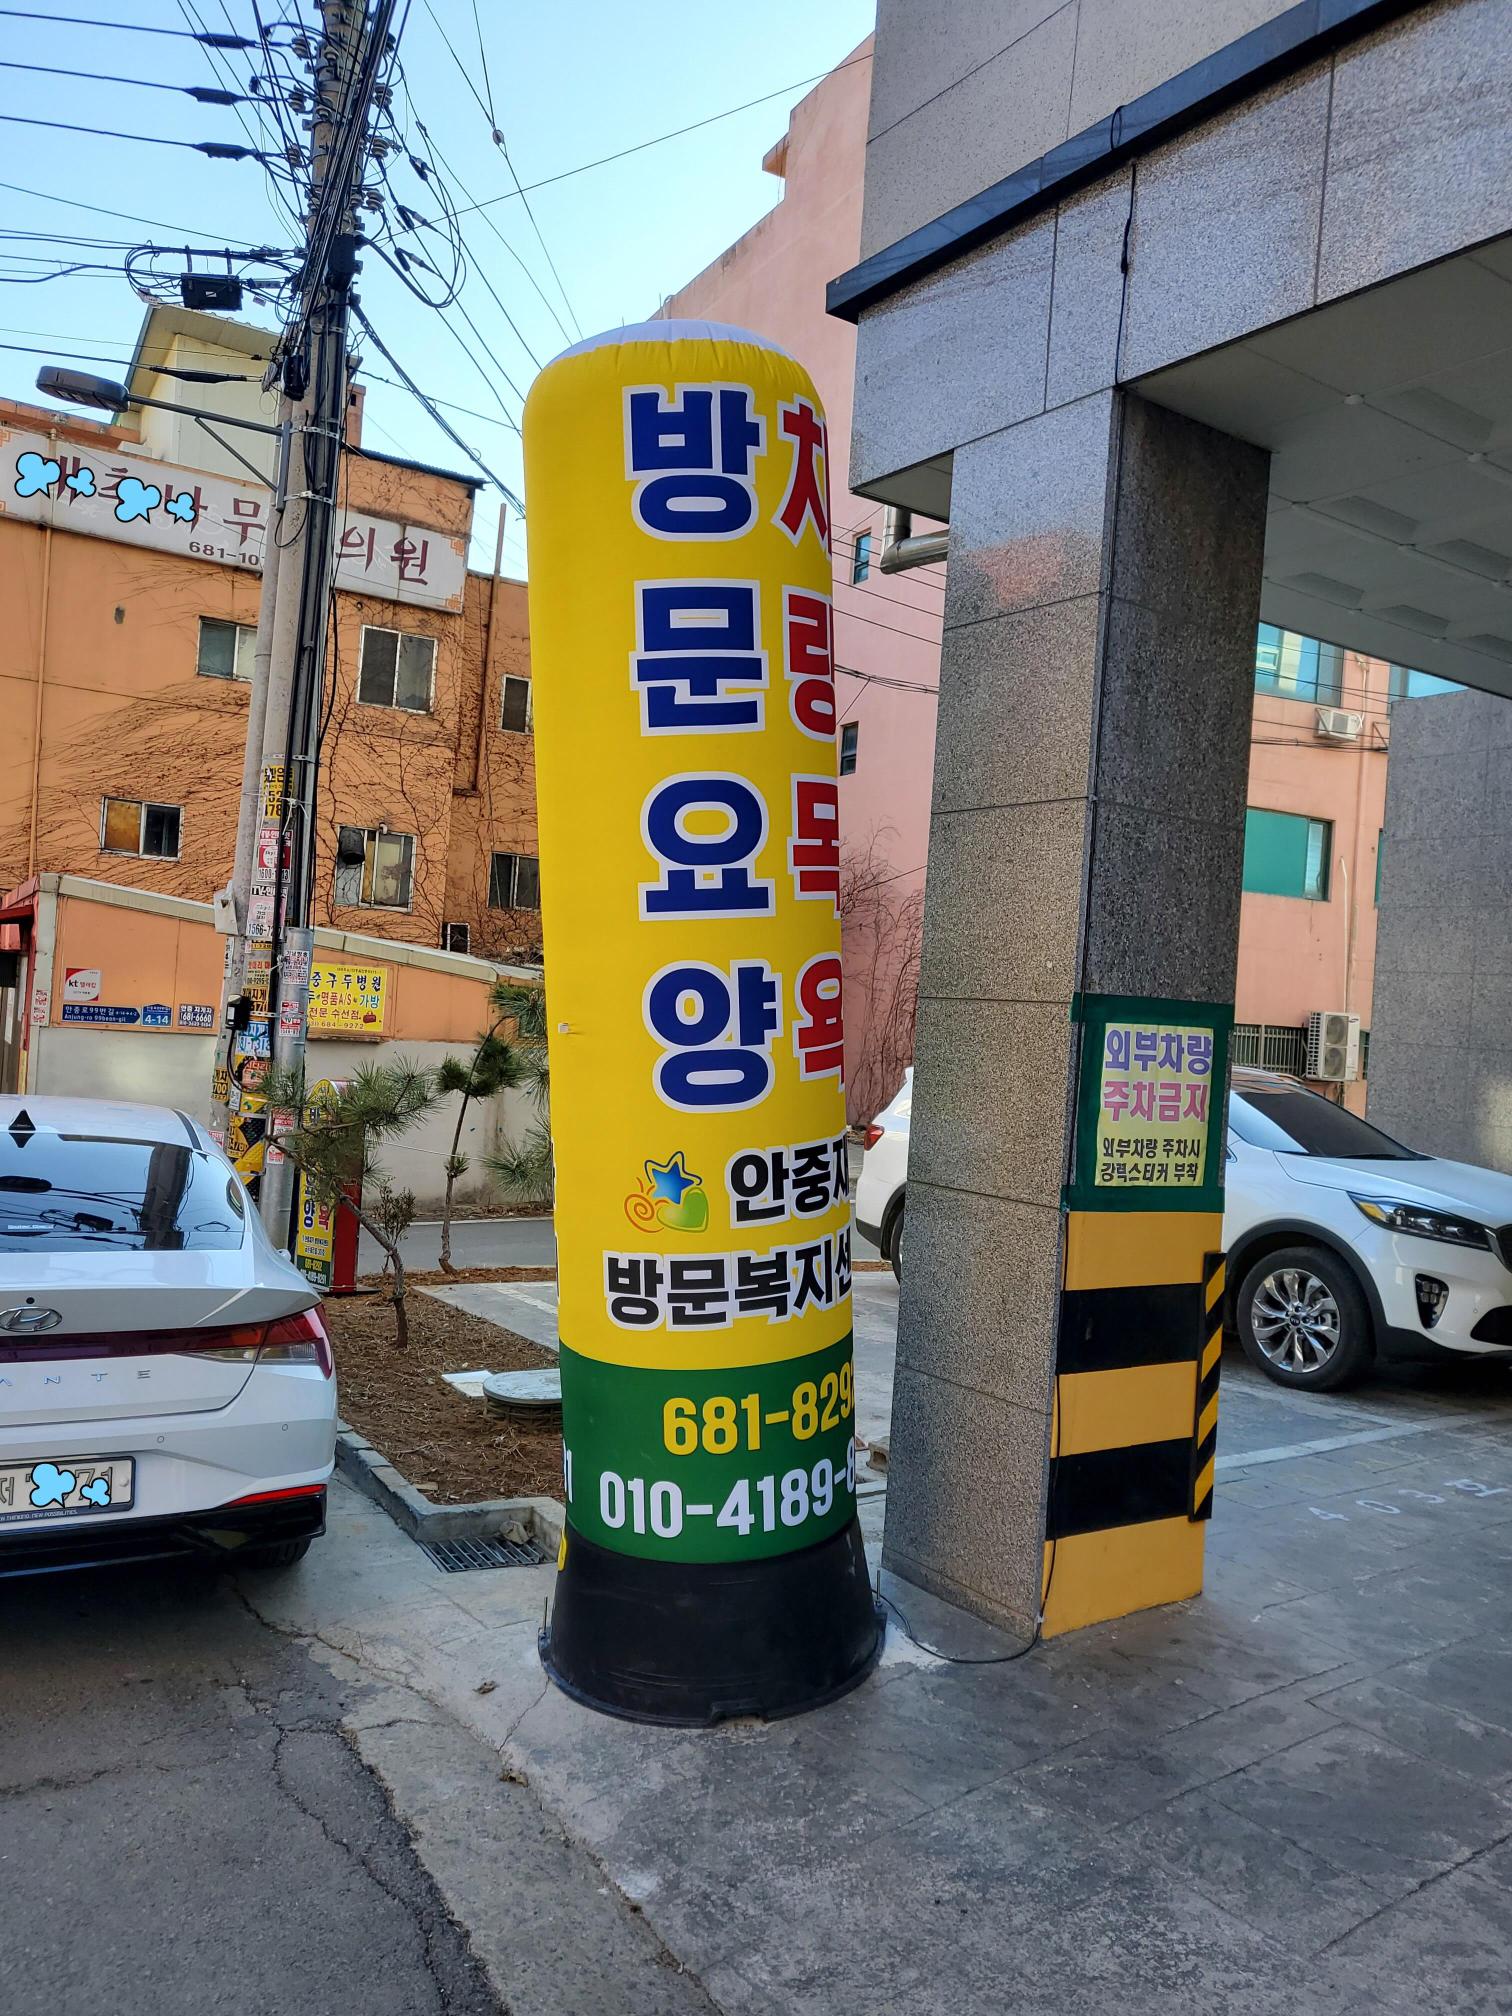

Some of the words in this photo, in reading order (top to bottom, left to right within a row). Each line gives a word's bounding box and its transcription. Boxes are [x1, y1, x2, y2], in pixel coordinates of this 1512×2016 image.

[189, 541, 265, 566] 681-10
[625, 382, 782, 1108] 방문요양
[145, 1014, 169, 1025] 4-14
[1105, 1029, 1212, 1075] 외부차량
[1103, 1080, 1208, 1122] 주차금지
[1103, 1137, 1158, 1159] 외부차량
[1162, 1138, 1201, 1159] 주차시
[1101, 1162, 1168, 1183] 강력스티커
[1174, 1163, 1198, 1182] 부착
